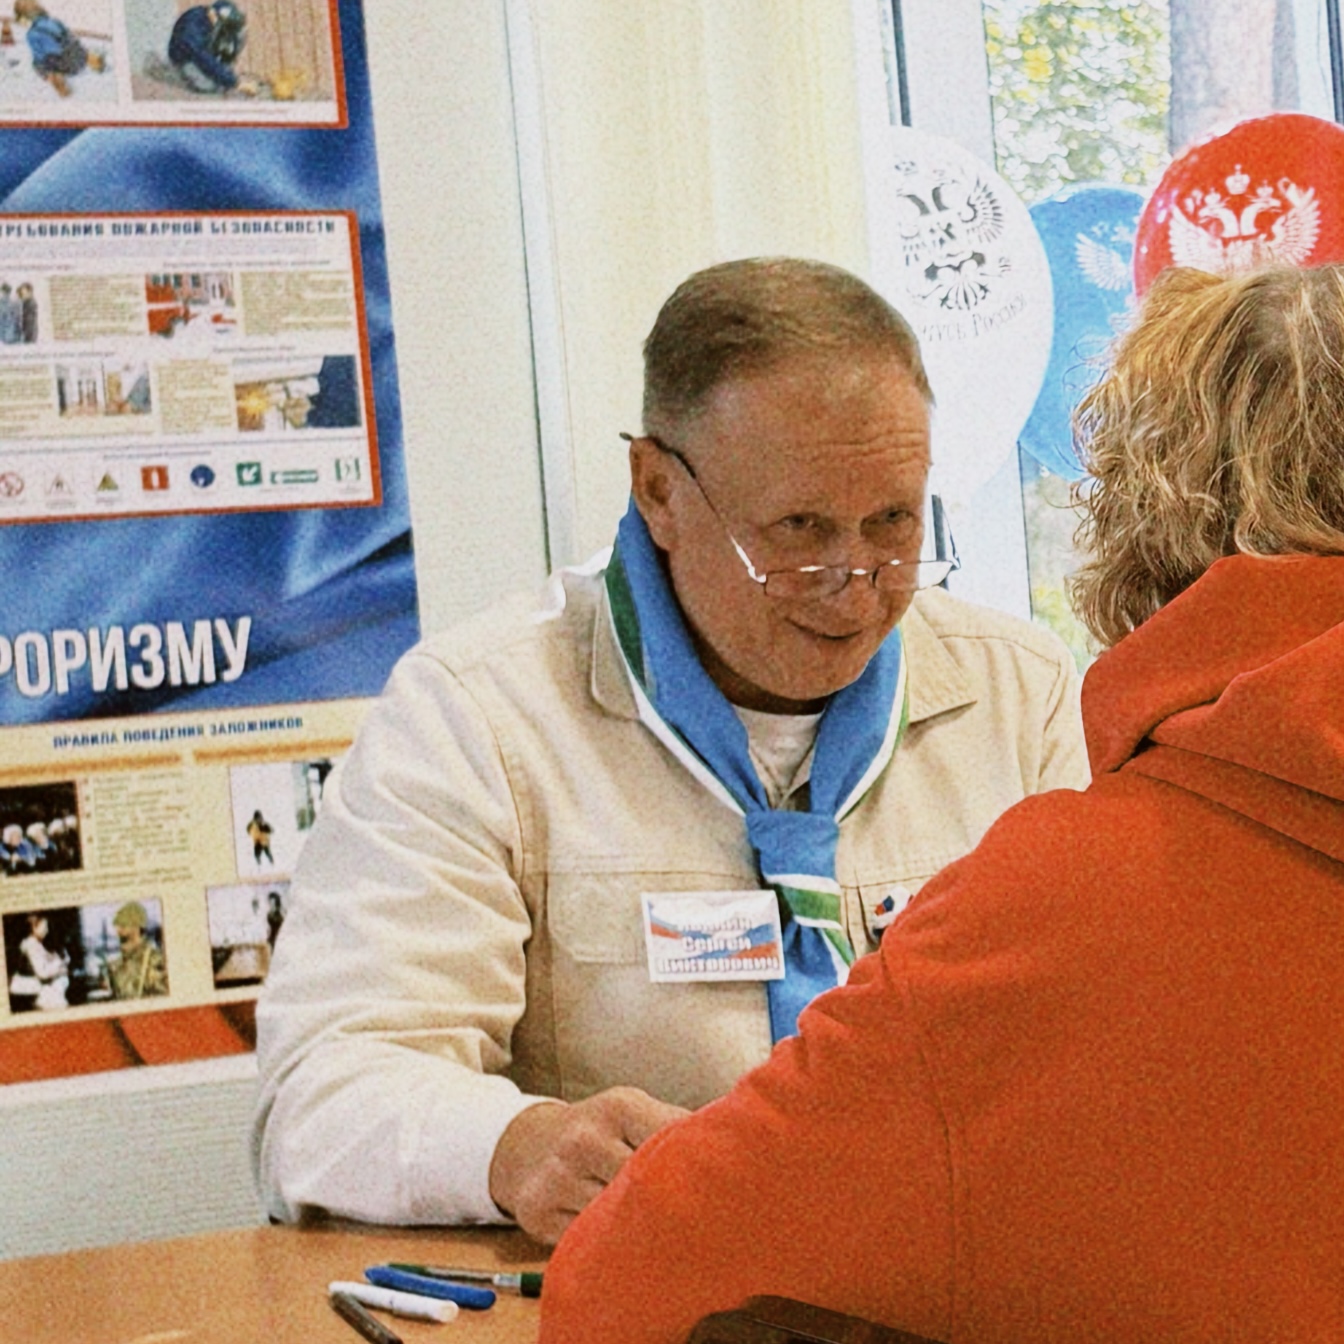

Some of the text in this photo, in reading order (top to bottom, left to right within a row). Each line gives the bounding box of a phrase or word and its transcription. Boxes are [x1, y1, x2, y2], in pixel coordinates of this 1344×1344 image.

[0, 222, 105, 238] РЕБОВАНИЯ
[53, 717, 304, 749] ПРАВИЛА ПОВЕДЕНИЯ ЗАЛОЖНИКОВ
